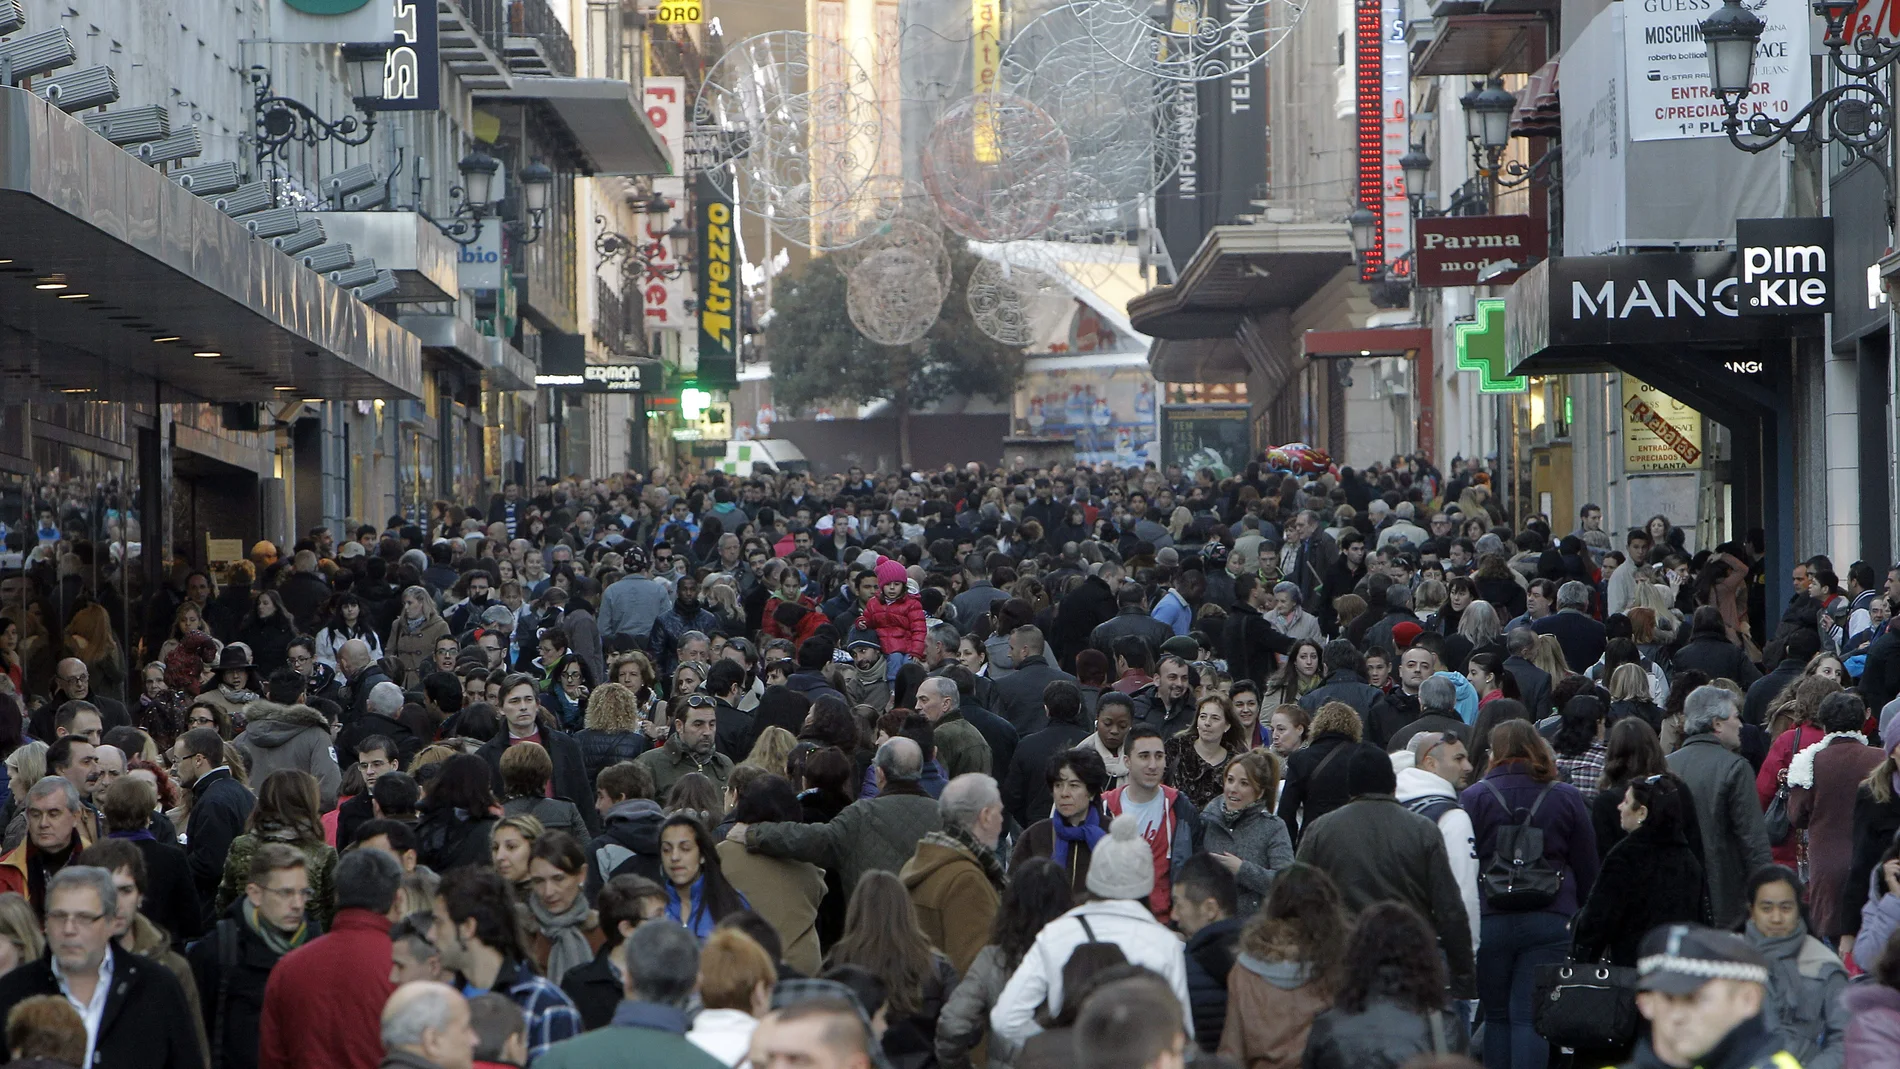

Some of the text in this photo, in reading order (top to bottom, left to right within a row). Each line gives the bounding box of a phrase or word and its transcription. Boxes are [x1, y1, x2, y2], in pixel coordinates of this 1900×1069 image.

[659, 6, 699, 21] ORO
[1644, 0, 1710, 13] GUESS
[1648, 53, 1677, 61] roberto
[1655, 101, 1748, 120] C/PRECIADS
[1772, 99, 1789, 112] 10
[1423, 233, 1521, 250] Parma
[457, 246, 498, 264] bio
[1744, 245, 1826, 284] pim
[703, 203, 731, 352] Atrezzo
